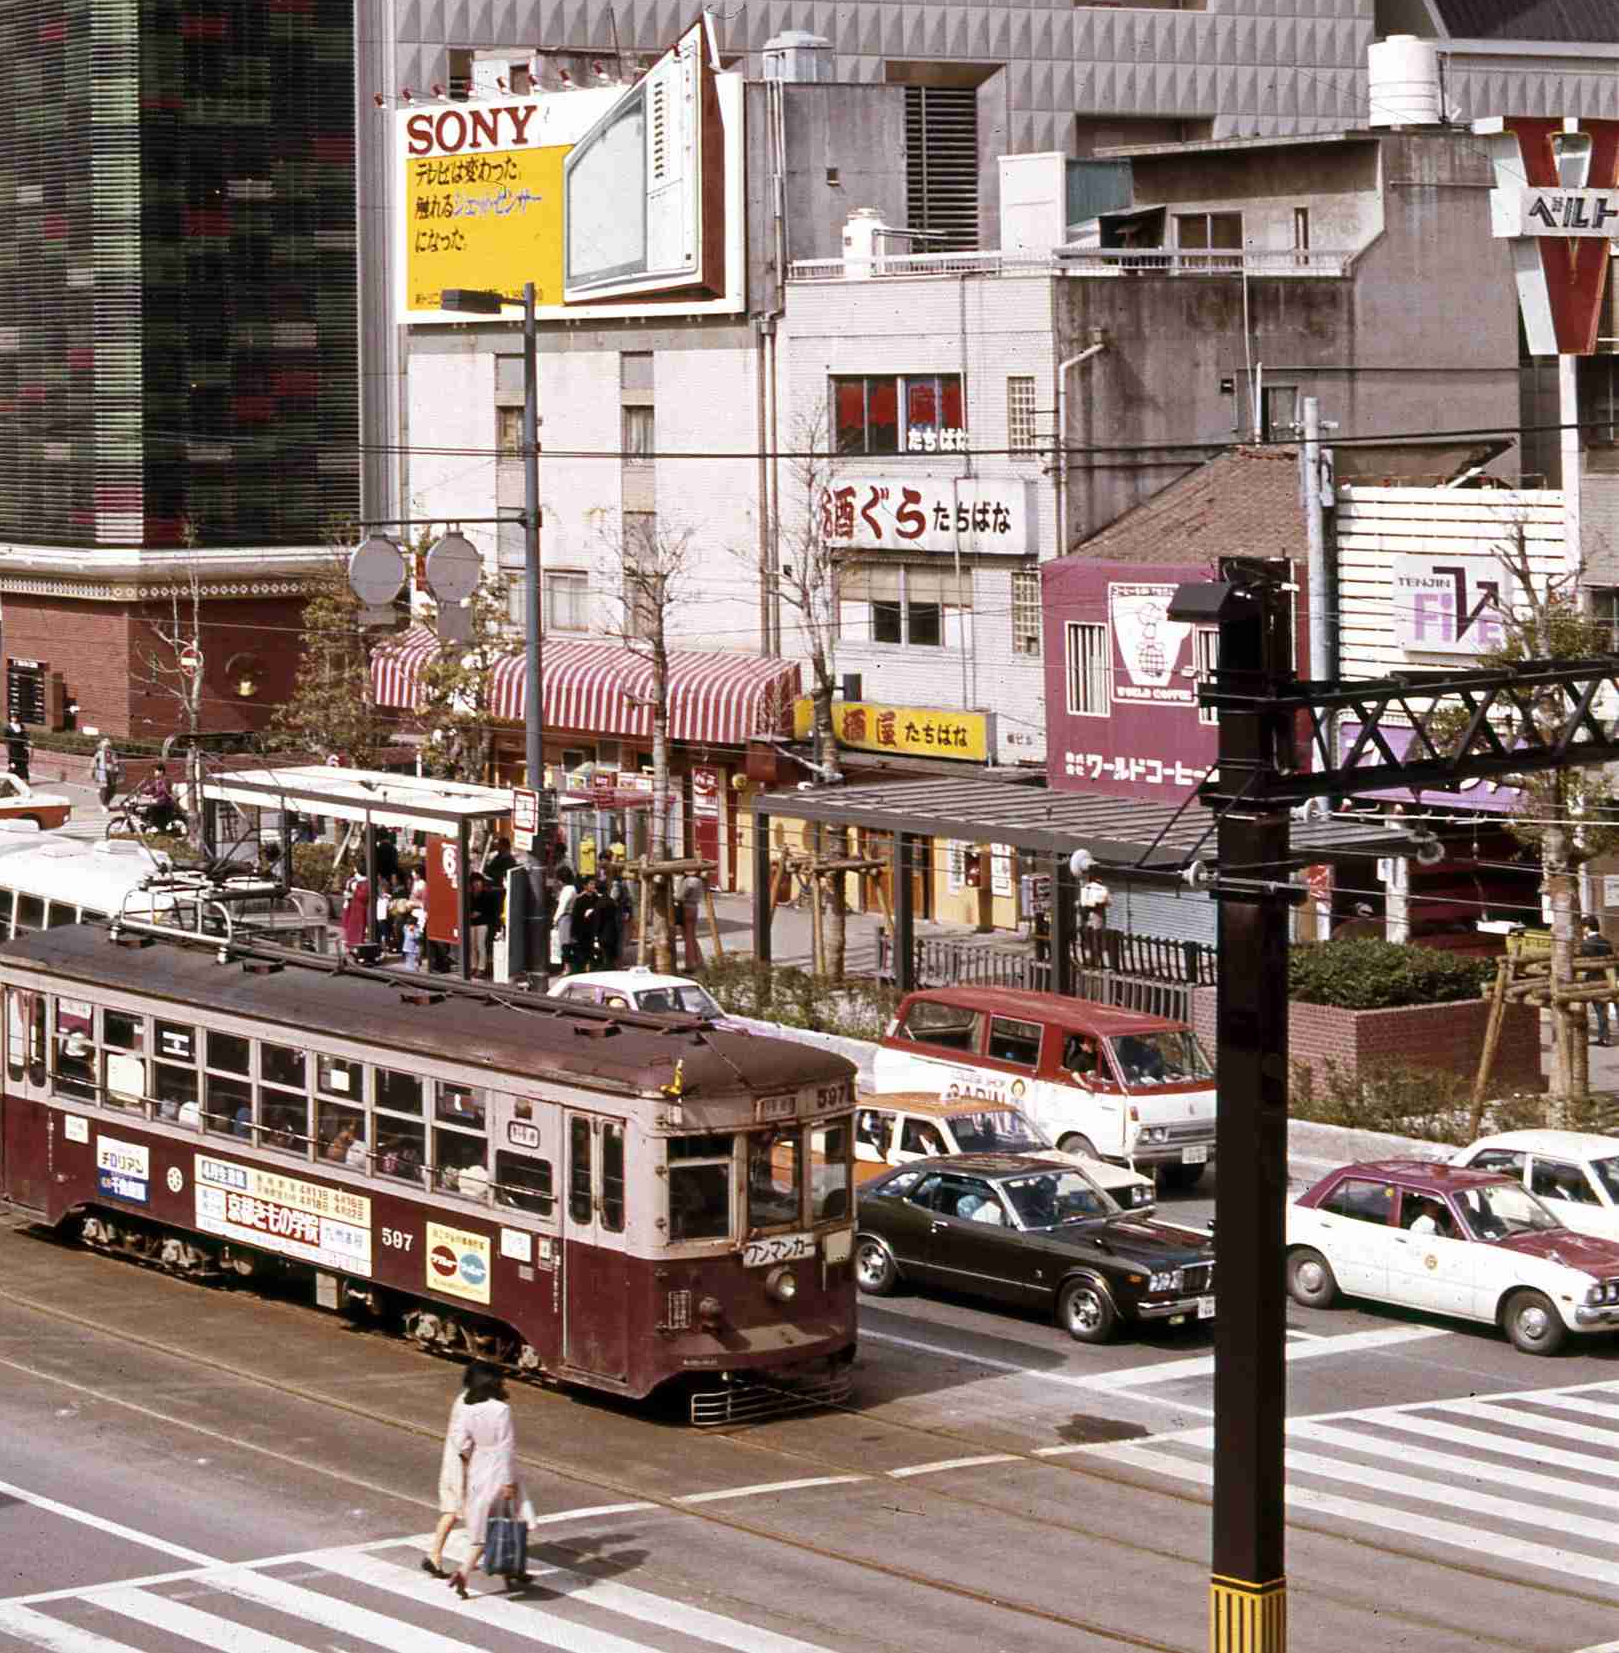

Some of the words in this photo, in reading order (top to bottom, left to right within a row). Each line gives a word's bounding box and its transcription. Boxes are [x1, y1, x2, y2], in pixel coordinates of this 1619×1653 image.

[406, 105, 537, 155] SONY
[821, 484, 928, 540] 酒ぐら
[931, 499, 1012, 535] たちばな
[1397, 577, 1451, 589] TENJIN
[904, 721, 969, 748] たちばな
[440, 847, 457, 875] 6
[816, 1085, 847, 1109] 597
[227, 1193, 319, 1246] 京都きもの学院
[382, 1226, 414, 1252] 597
[744, 1234, 815, 1266] ワンマンカー
